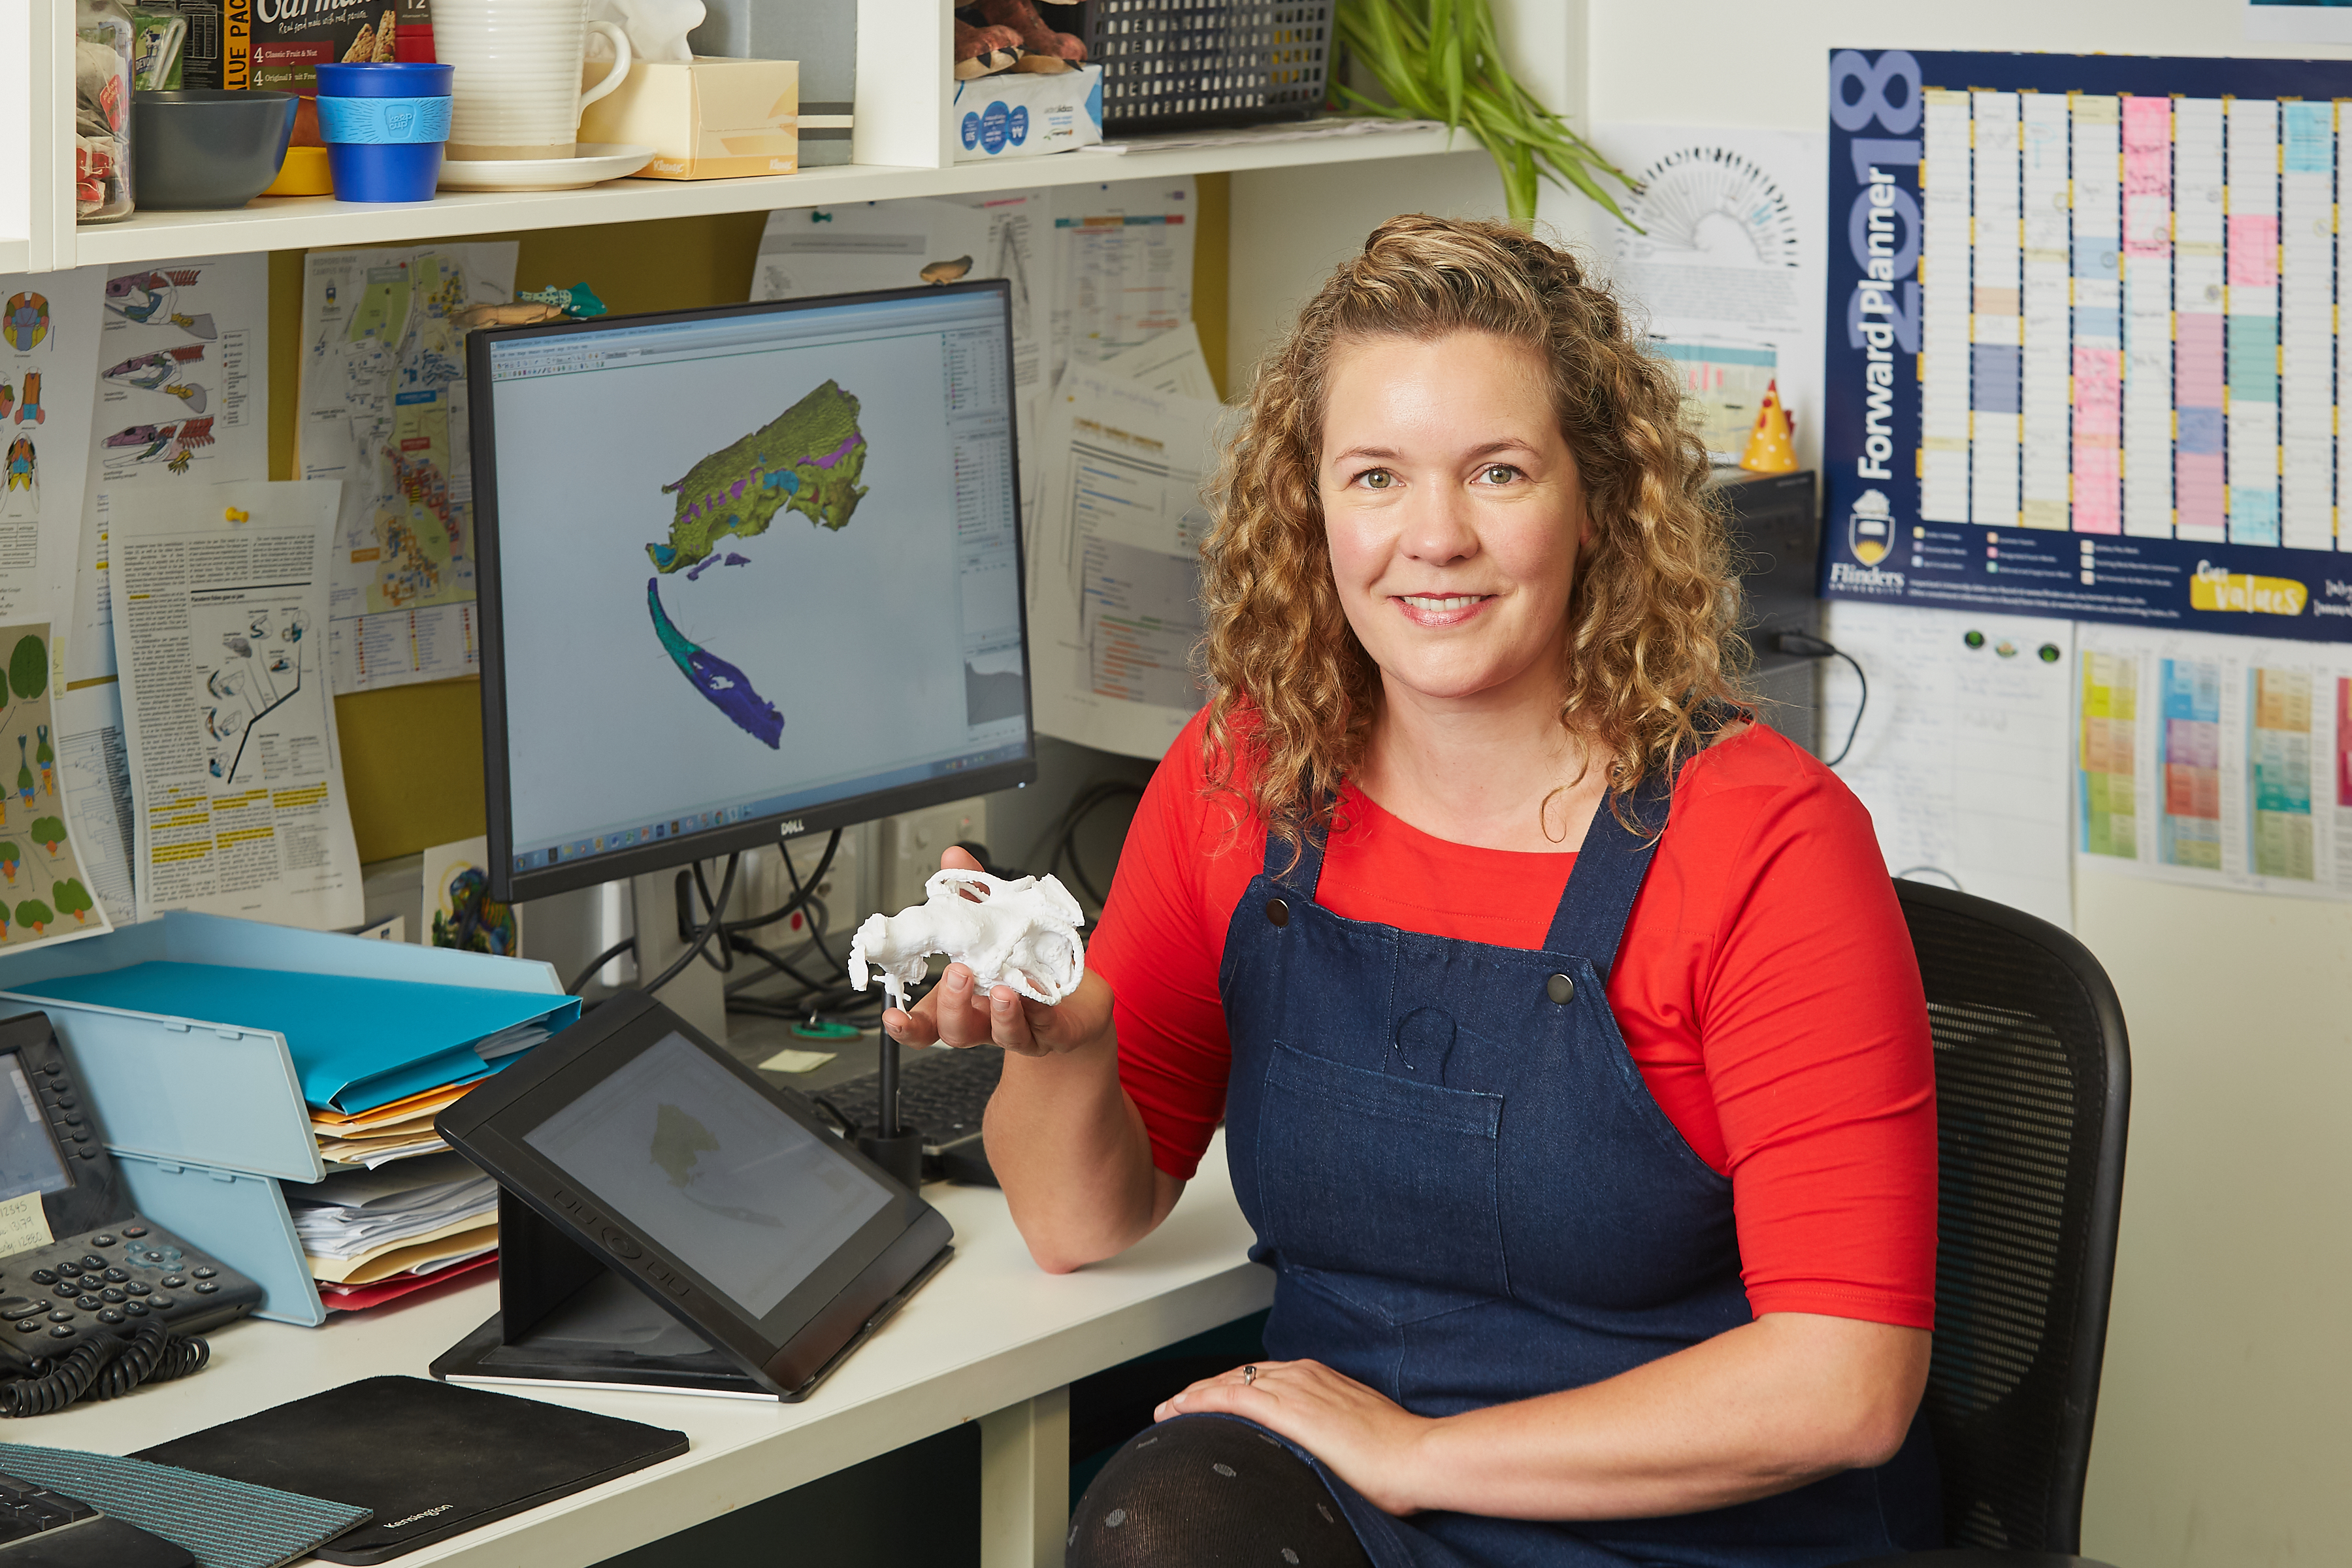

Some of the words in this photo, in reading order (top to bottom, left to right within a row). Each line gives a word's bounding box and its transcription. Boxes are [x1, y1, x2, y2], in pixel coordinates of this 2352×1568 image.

[279, 22, 293, 35] Real
[294, 20, 307, 33] food
[253, 47, 264, 63] 4
[229, 47, 249, 90] LUE
[253, 71, 264, 86] 4
[265, 73, 288, 82] Original
[388, 112, 413, 123] keep
[389, 121, 408, 130] cup
[653, 160, 685, 174] Kleenex
[1857, 167, 1895, 315] Planner
[1857, 324, 1893, 480] Forward
[1831, 562, 1906, 588] Flinders
[780, 818, 805, 836] DELL
[383, 1504, 454, 1528] Kensington
